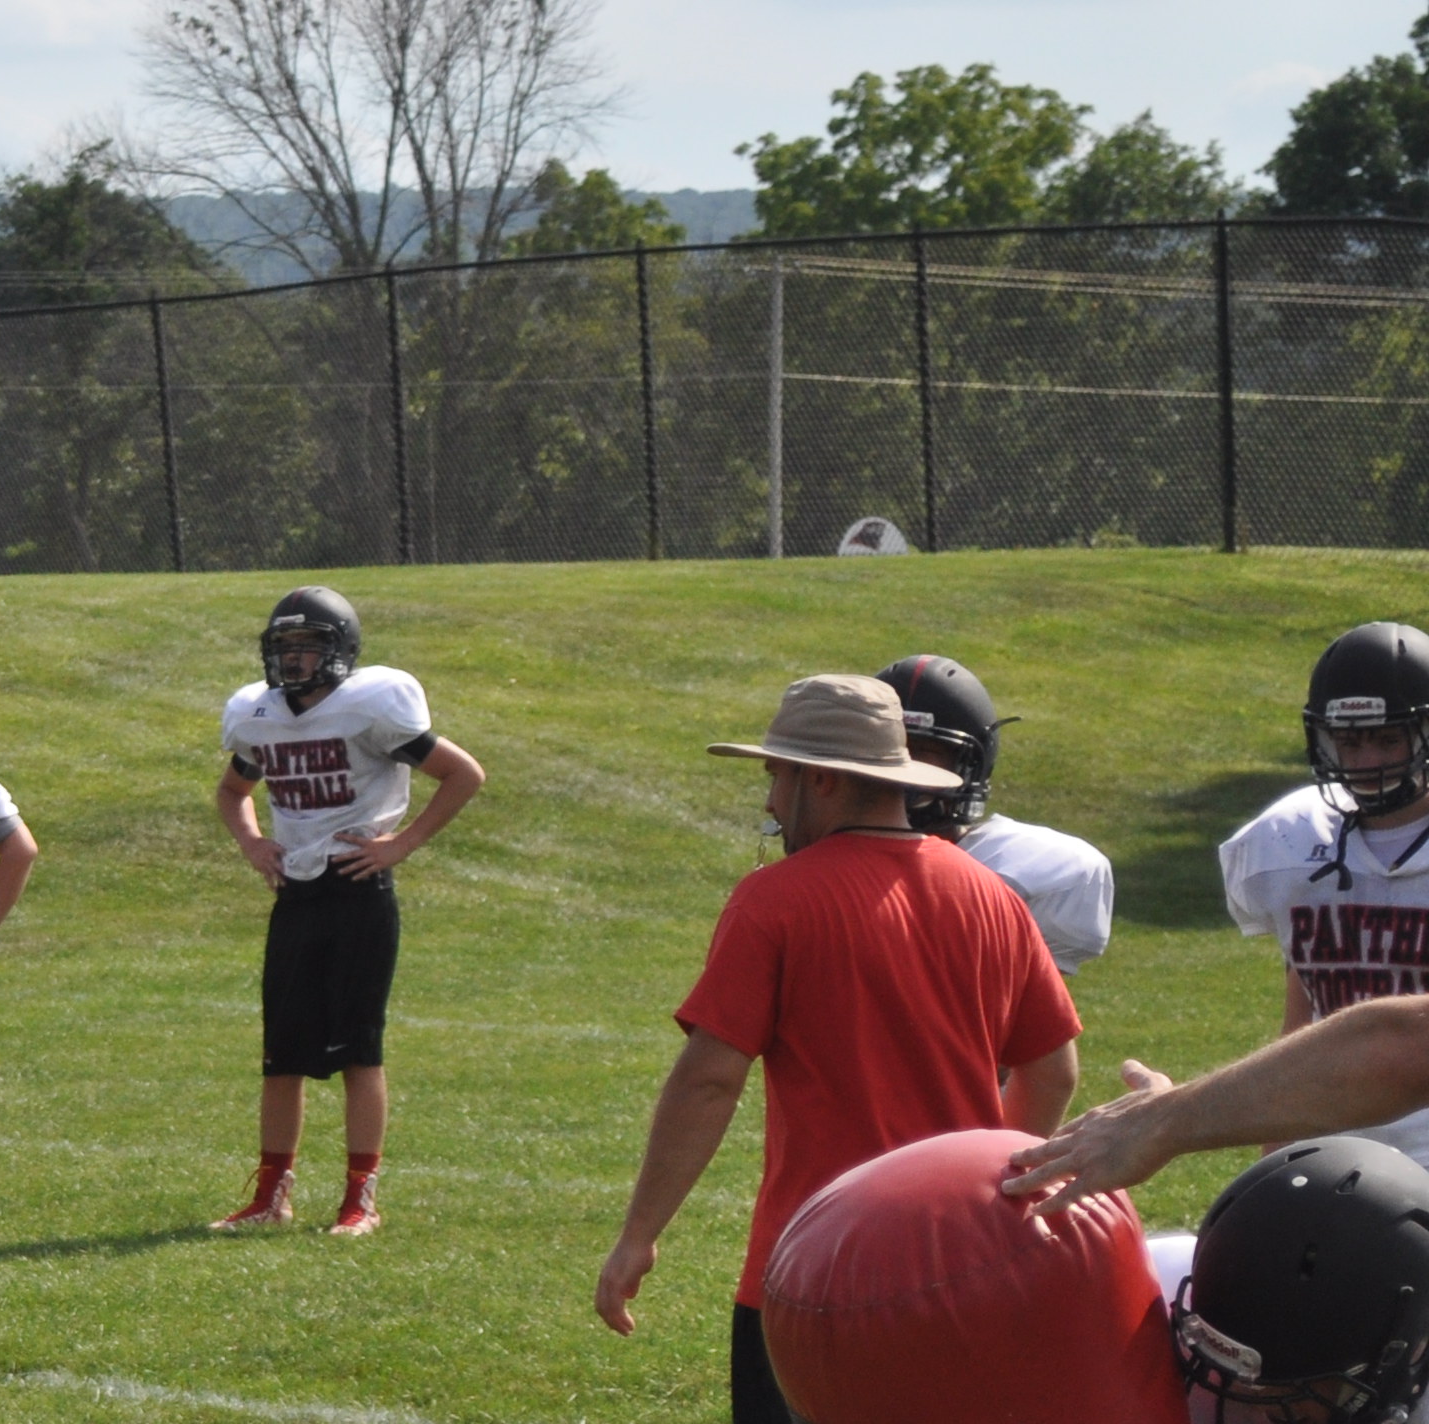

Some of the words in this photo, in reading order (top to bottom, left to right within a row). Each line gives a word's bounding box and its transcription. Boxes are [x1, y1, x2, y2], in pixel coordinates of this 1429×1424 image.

[251, 738, 351, 776] PANTHER
[265, 774, 355, 810] OOTBALL
[1289, 904, 1429, 965] PANTH
